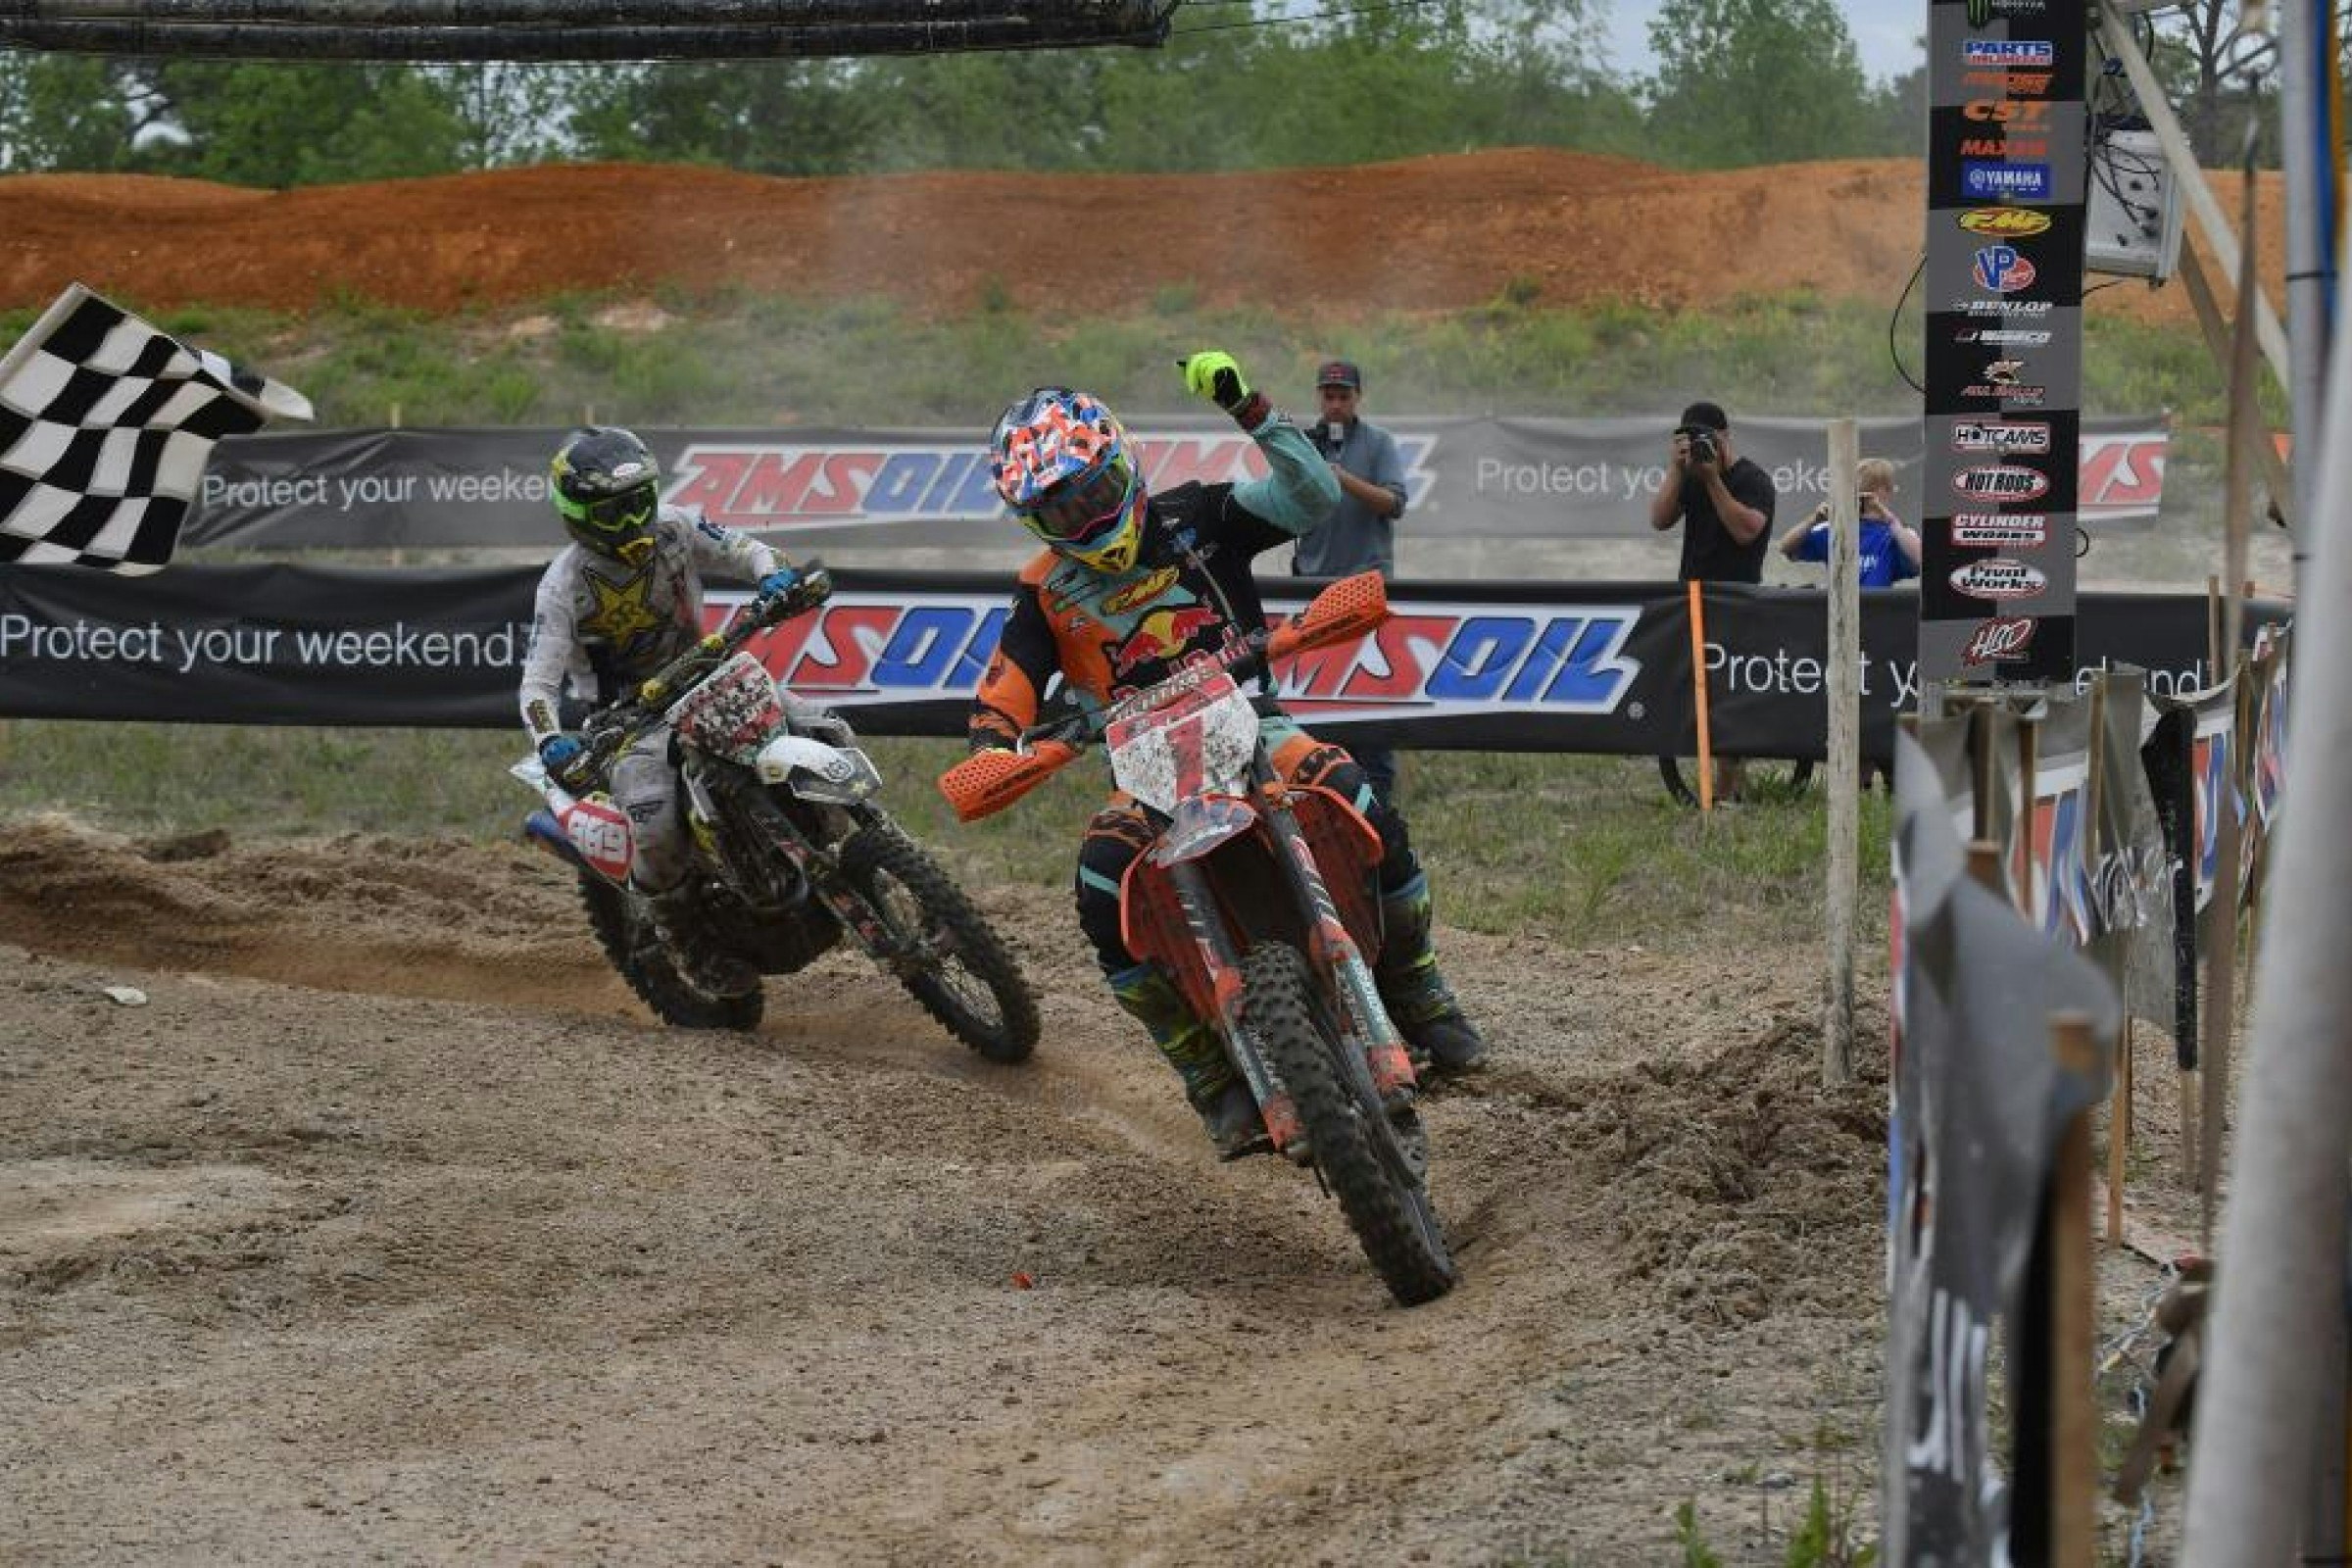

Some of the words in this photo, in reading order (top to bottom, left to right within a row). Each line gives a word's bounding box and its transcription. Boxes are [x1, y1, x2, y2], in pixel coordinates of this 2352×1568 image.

[1986, 171, 2041, 186] YAMAHA
[1976, 246, 2016, 290] VP
[203, 474, 328, 507] Protect
[339, 474, 417, 513] your
[427, 466, 553, 503] weeke
[1476, 458, 1608, 494] Protect
[1622, 465, 1662, 502] yo
[1955, 514, 2045, 527] CYLINDER
[0, 613, 163, 662] Protect
[176, 628, 282, 674] your
[1264, 610, 1627, 710] MSOIL
[1704, 642, 1873, 696] Protet
[1166, 714, 1204, 802] 1
